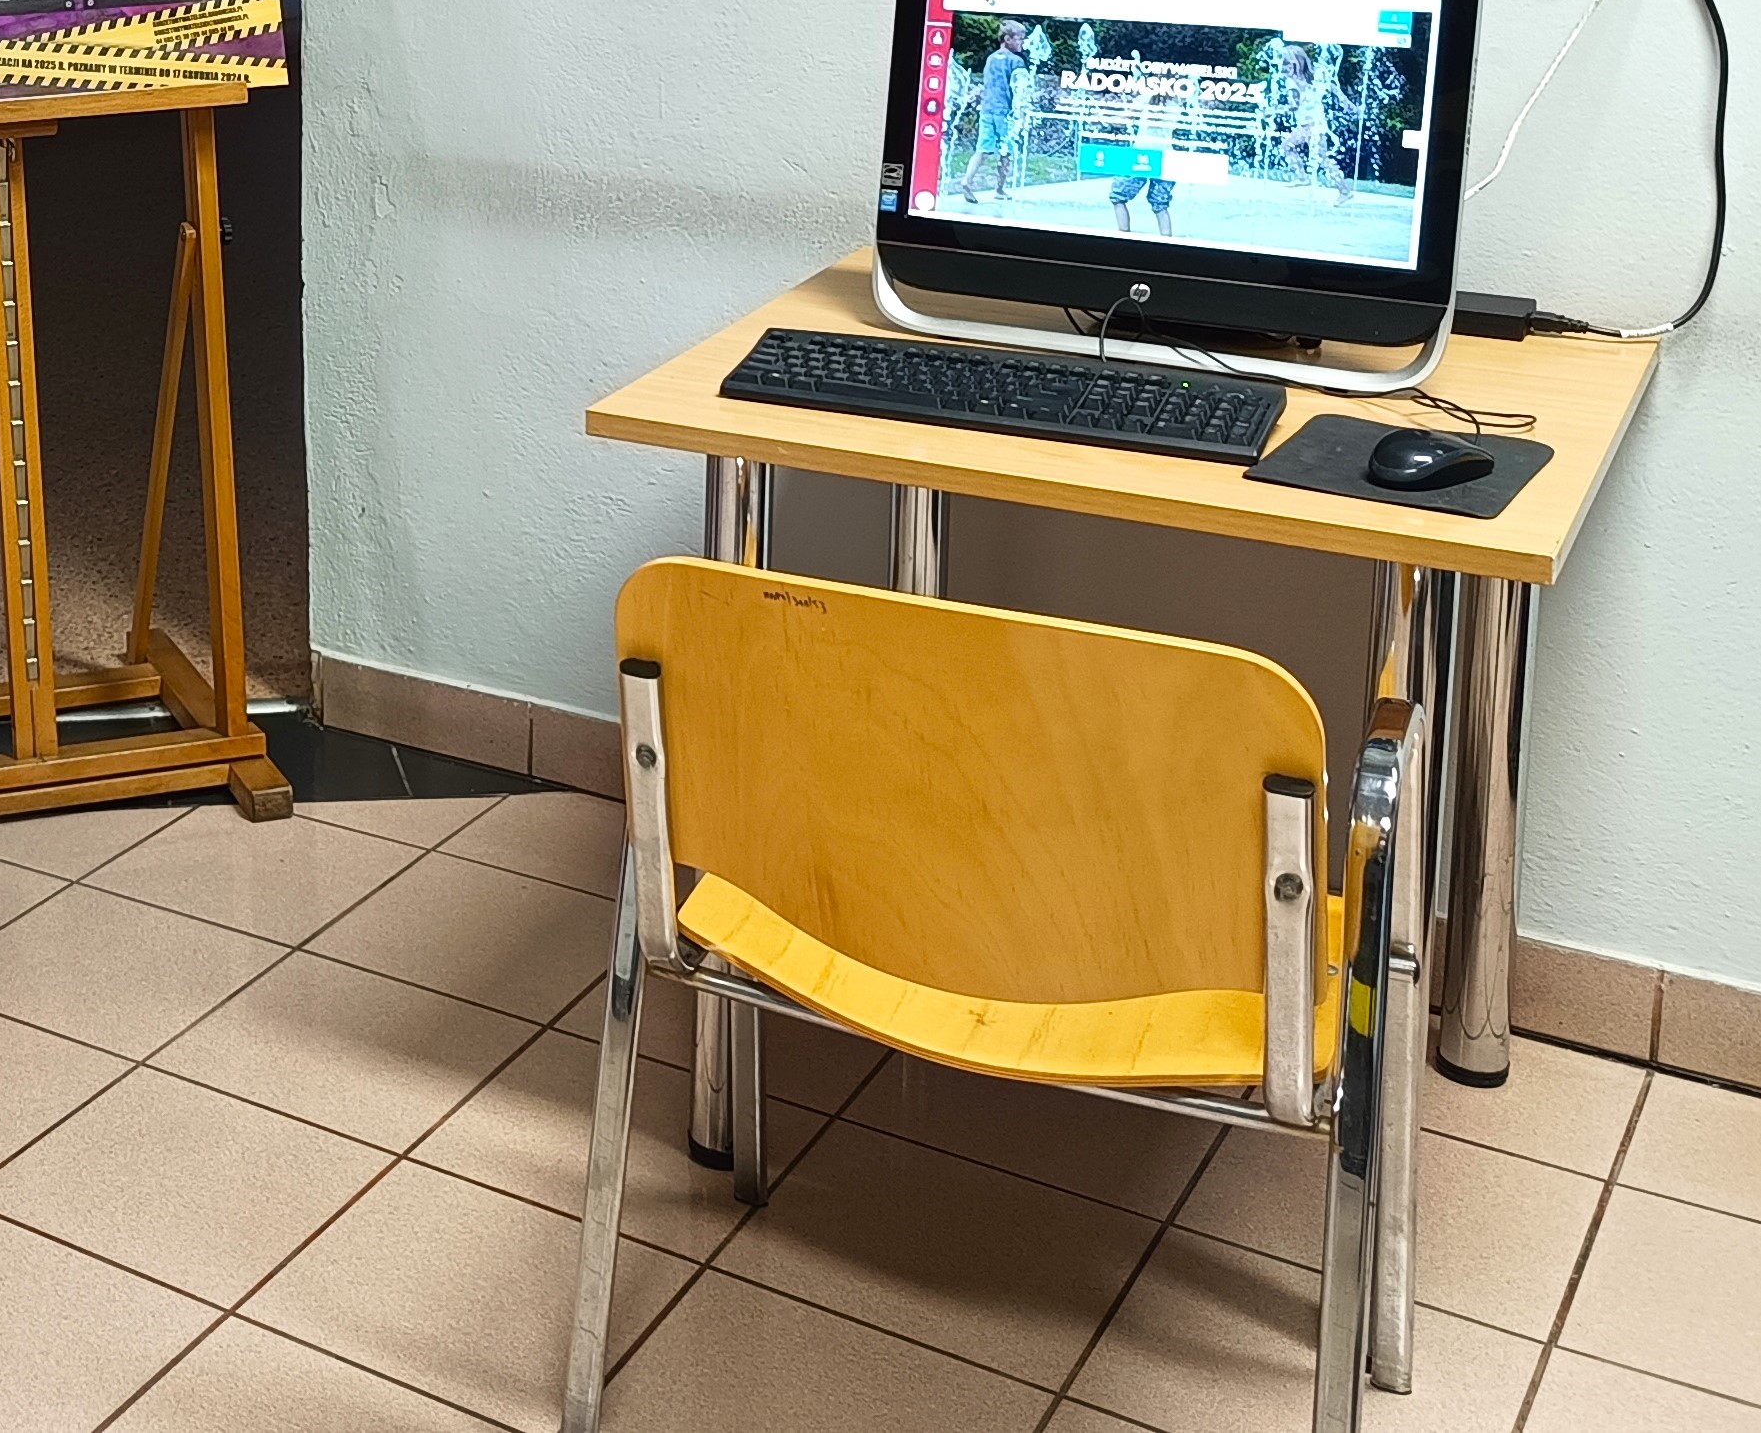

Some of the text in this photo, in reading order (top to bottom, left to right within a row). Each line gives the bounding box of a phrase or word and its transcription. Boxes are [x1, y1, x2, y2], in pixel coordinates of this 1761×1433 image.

[22, 59, 32, 68] NA
[35, 60, 56, 70] 2025
[59, 61, 67, 71] R.
[68, 61, 106, 74] POZNAMY
[108, 64, 117, 74] W
[120, 66, 157, 77] TERMINIE
[159, 67, 170, 77] DO
[173, 69, 180, 78] 17
[183, 69, 219, 80] GRUDNIA
[243, 73, 251, 82] R.
[1143, 61, 1237, 79] OBYWATELSKI
[1061, 71, 1266, 103] RADOMSKO 2025
